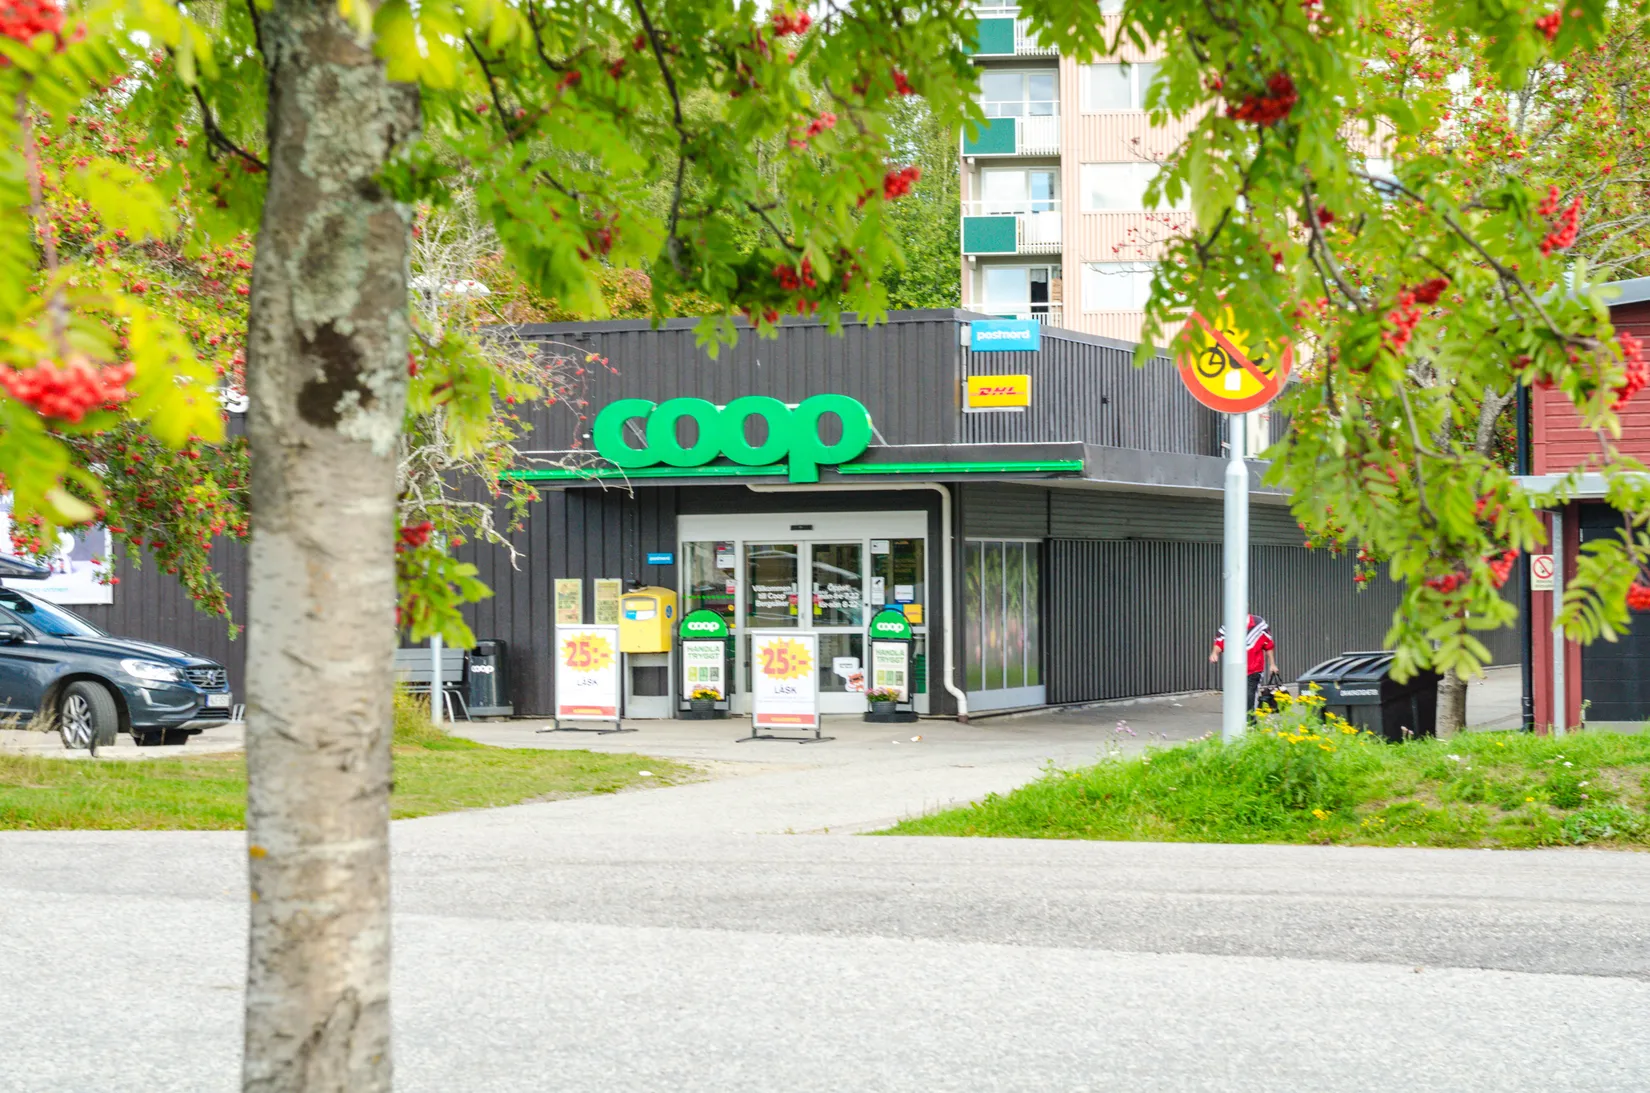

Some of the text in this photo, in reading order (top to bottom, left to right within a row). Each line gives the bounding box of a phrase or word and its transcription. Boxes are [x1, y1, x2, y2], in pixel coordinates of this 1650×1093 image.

[976, 329, 1031, 341] postnord
[979, 387, 1017, 396] DHL
[593, 393, 874, 483] coop
[687, 621, 720, 632] coop
[876, 622, 905, 633] coop
[566, 641, 609, 667] 25:-
[762, 647, 807, 675] 25:-
[470, 665, 495, 674] coop
